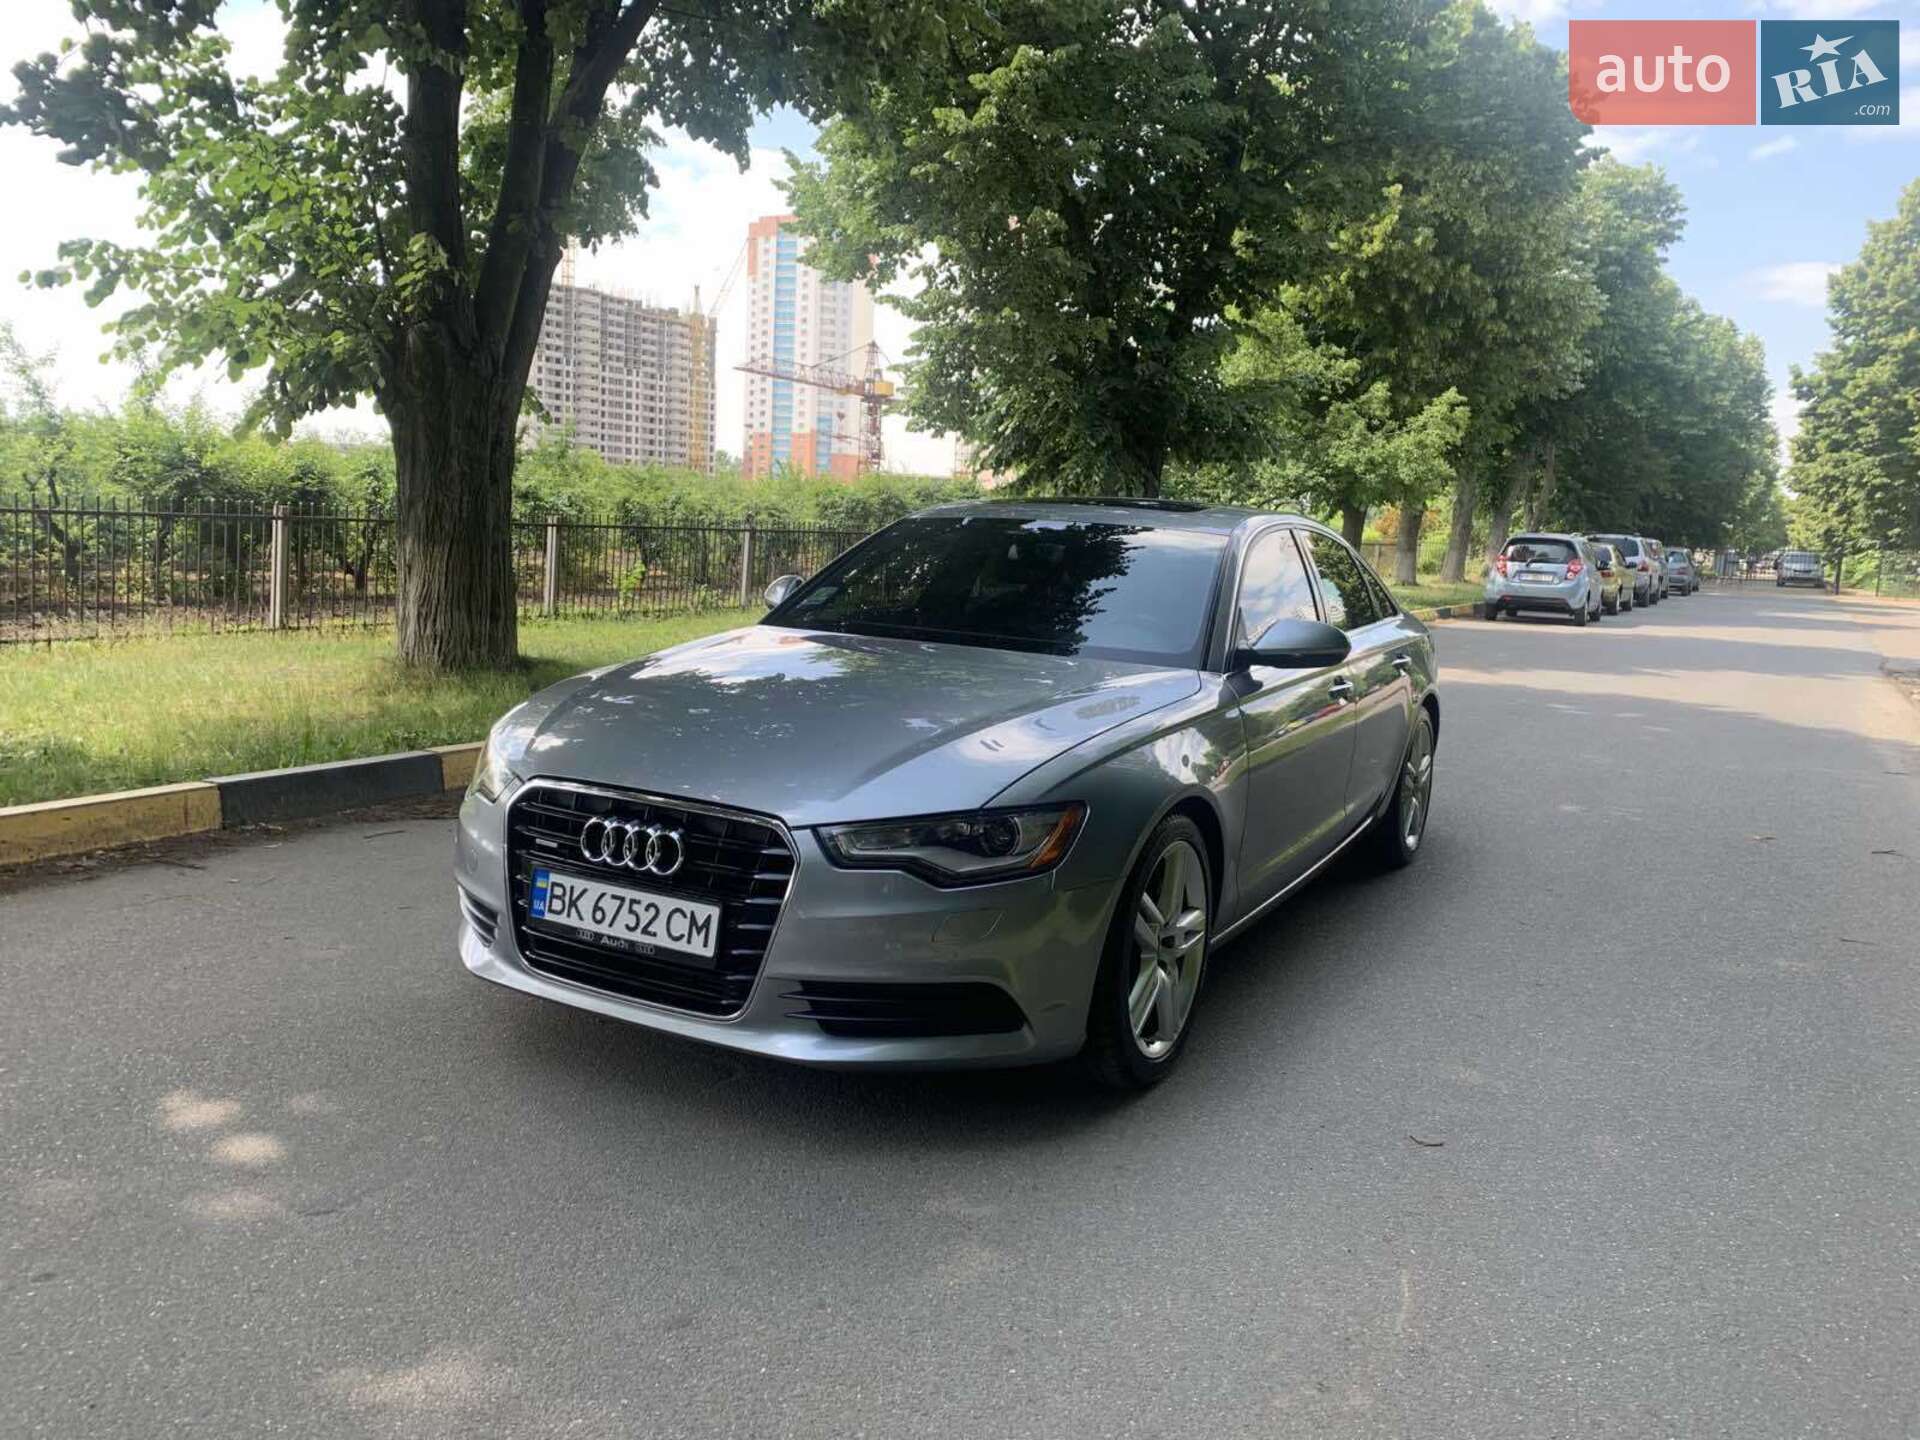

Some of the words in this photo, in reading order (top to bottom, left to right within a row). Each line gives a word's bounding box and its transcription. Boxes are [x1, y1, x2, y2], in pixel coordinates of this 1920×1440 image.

[547, 881, 589, 921] BK
[591, 892, 661, 938] 6752
[665, 907, 712, 949] CM
